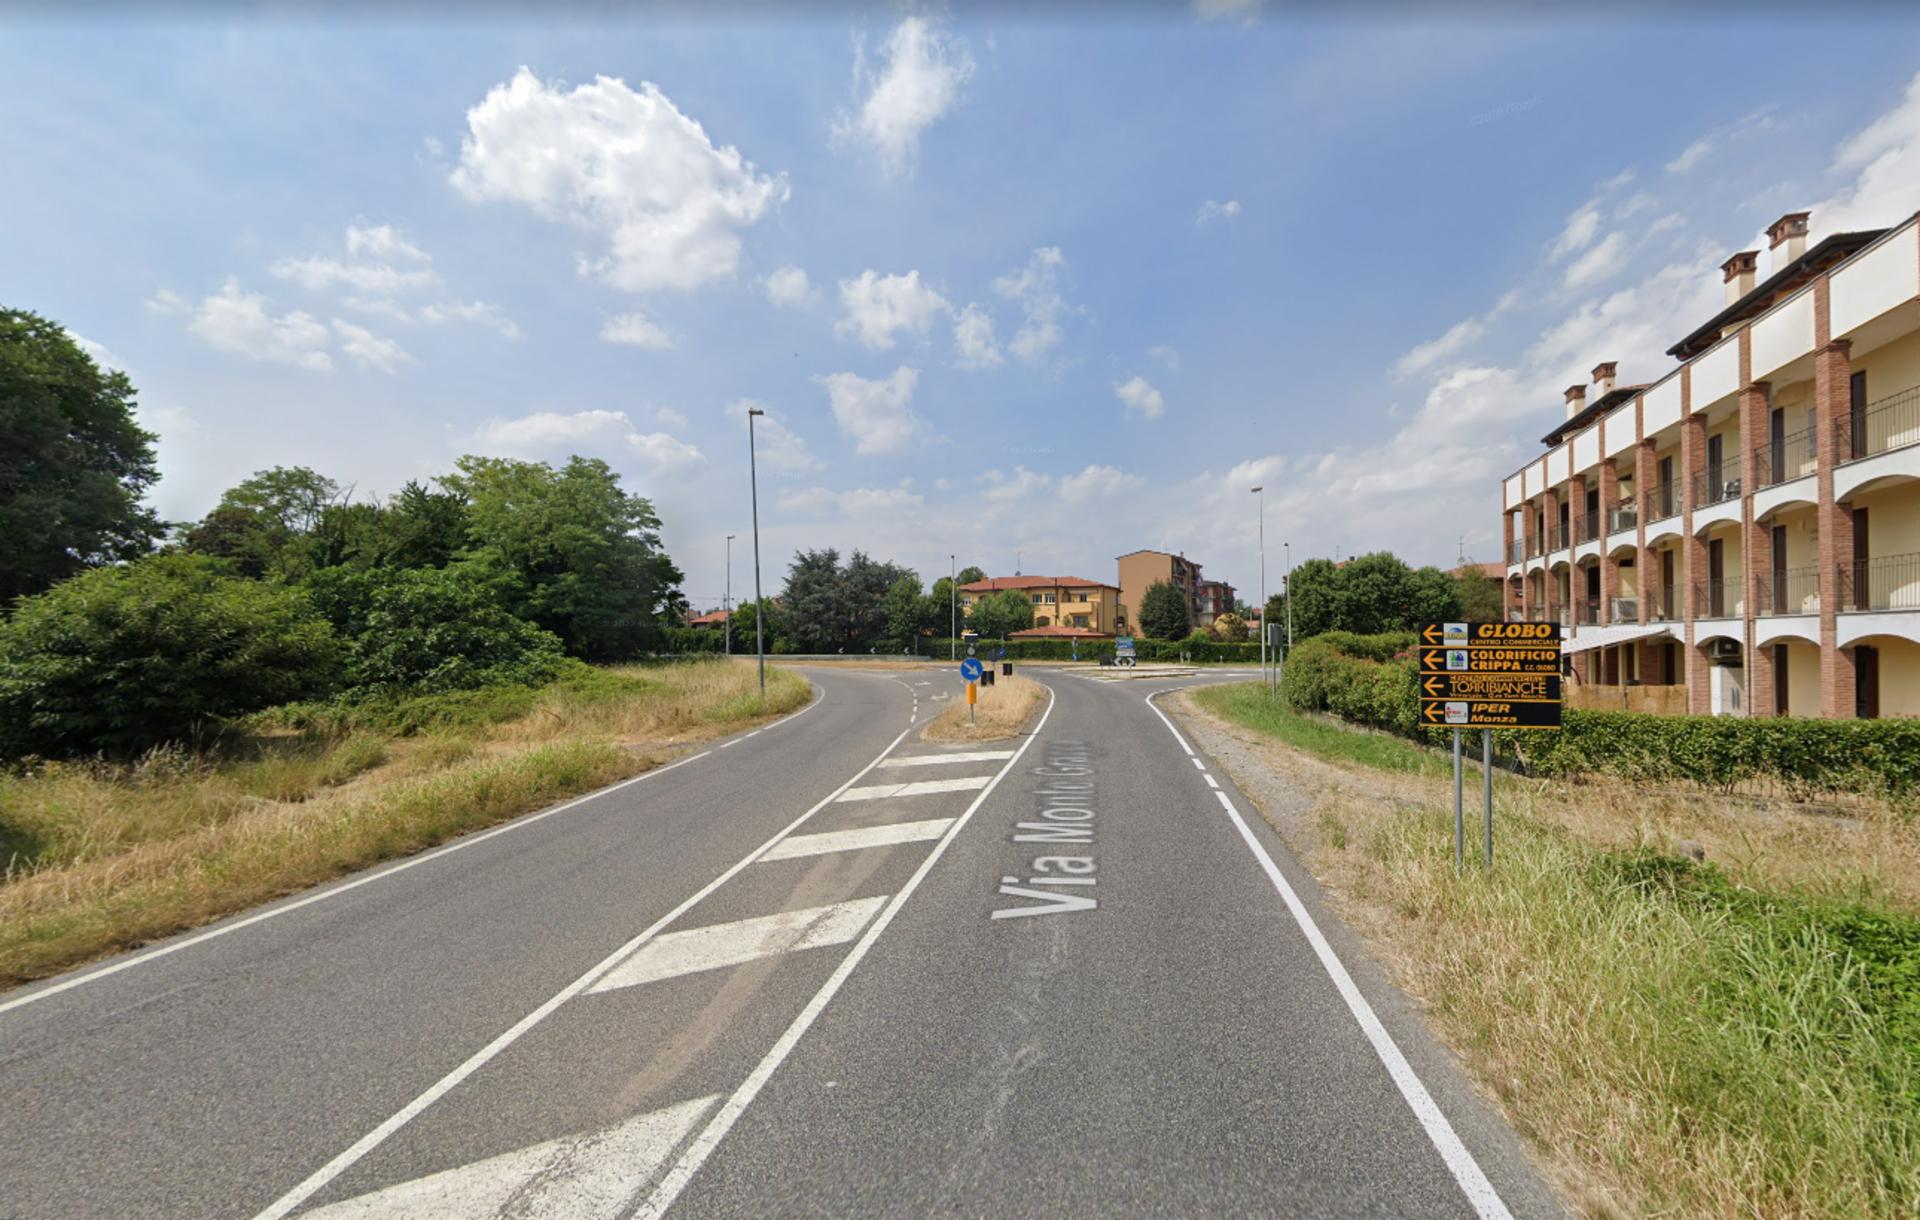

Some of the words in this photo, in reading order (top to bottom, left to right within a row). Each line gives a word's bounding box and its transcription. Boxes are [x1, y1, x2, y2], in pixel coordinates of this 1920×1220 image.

[1477, 623, 1552, 638] GLOBO
[1470, 650, 1556, 661] COLORIFICIO
[1470, 660, 1521, 671] CRIPPA
[1471, 703, 1511, 713] IPER
[1470, 714, 1518, 723] Monza
